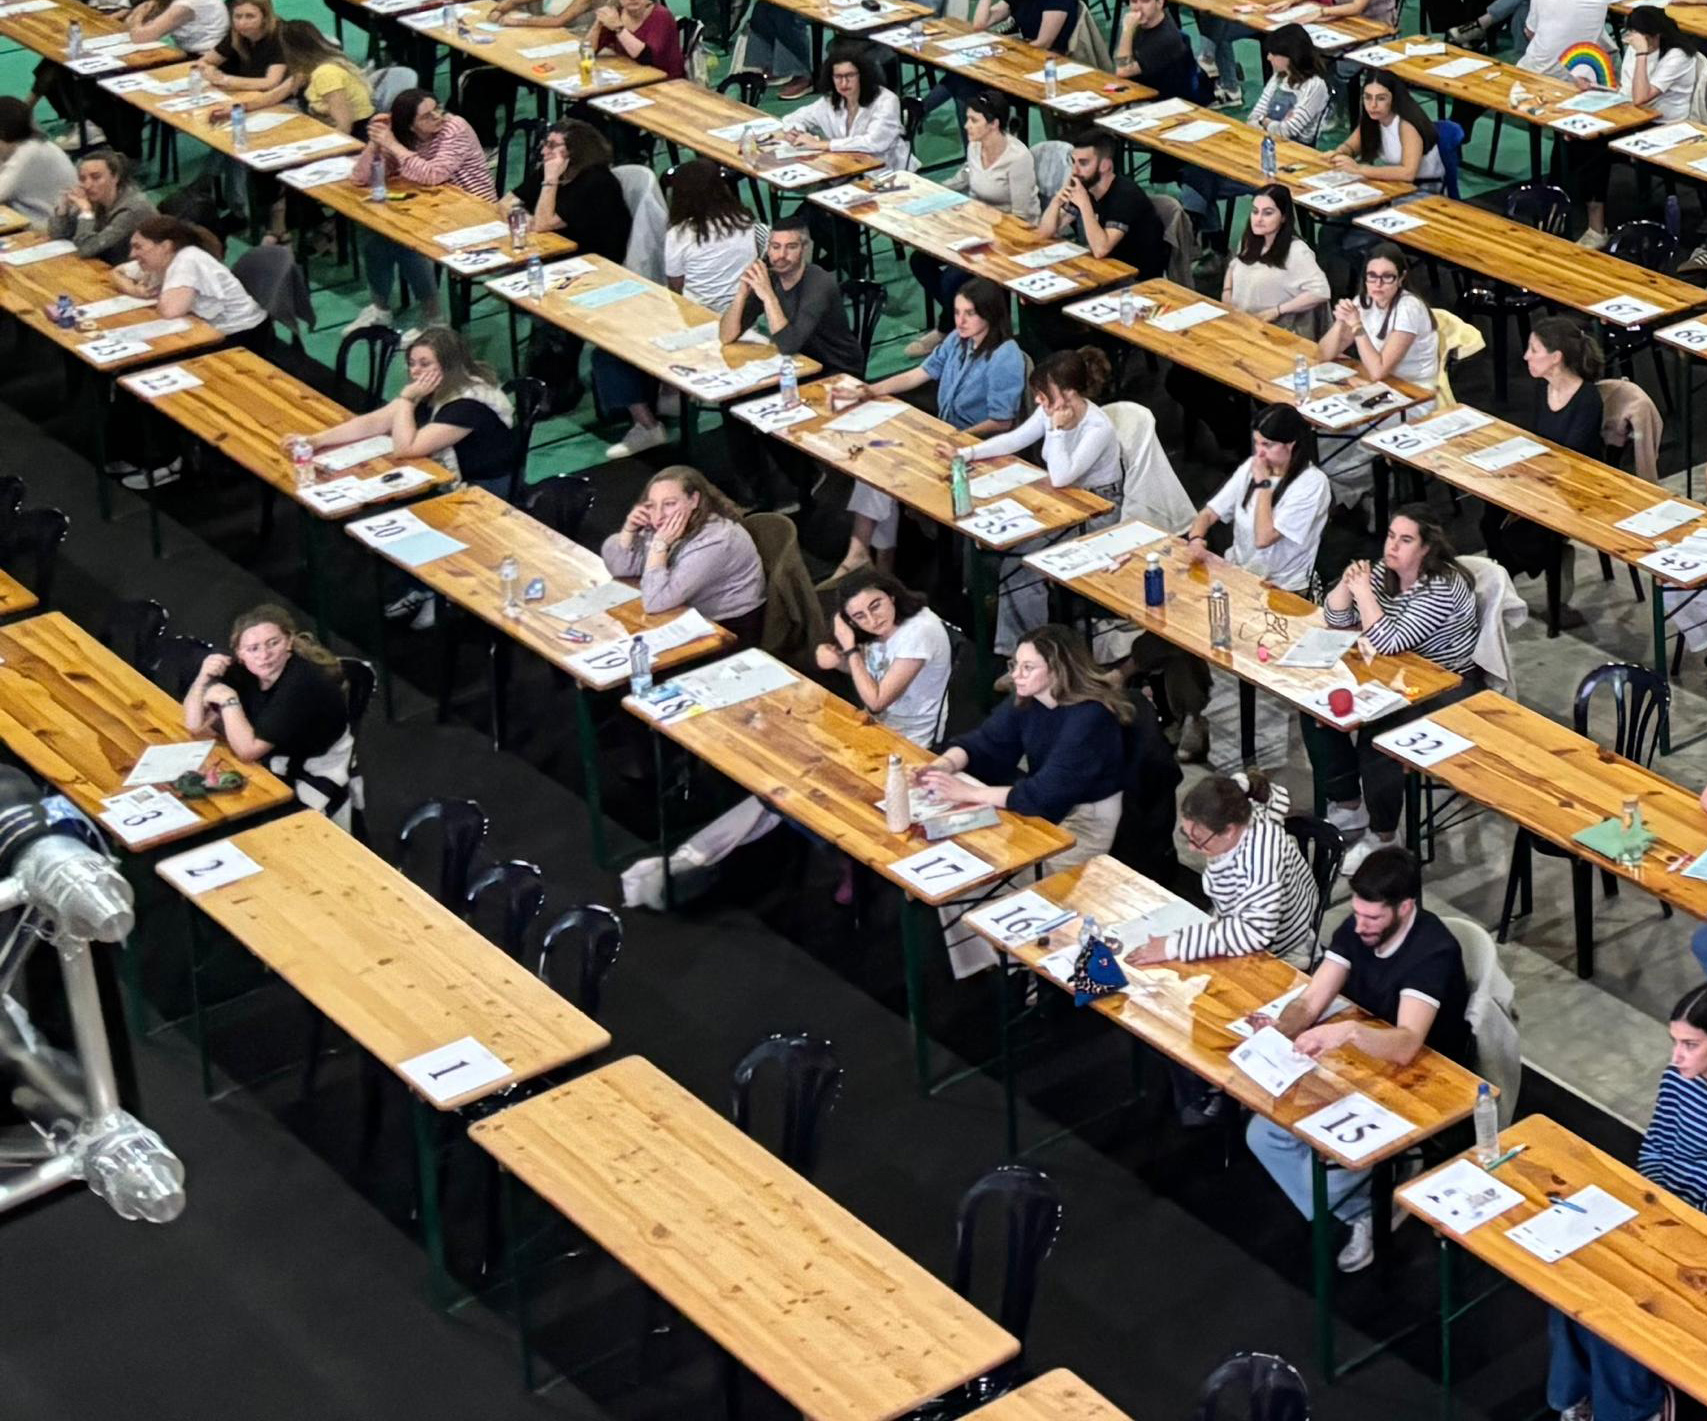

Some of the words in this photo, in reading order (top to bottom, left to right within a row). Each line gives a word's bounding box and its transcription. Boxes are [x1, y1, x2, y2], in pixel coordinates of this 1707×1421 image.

[1311, 403, 1349, 419] 51
[1380, 433, 1421, 449] 50
[365, 520, 406, 538] 20
[975, 517, 1019, 534] 35
[1660, 557, 1700, 571] 49
[585, 651, 629, 669] 19
[1395, 732, 1443, 755] 32
[186, 859, 224, 877] 2
[911, 856, 964, 880] 17
[990, 906, 1034, 932] 16
[429, 1060, 470, 1081] 1
[1320, 1111, 1381, 1143] 15
